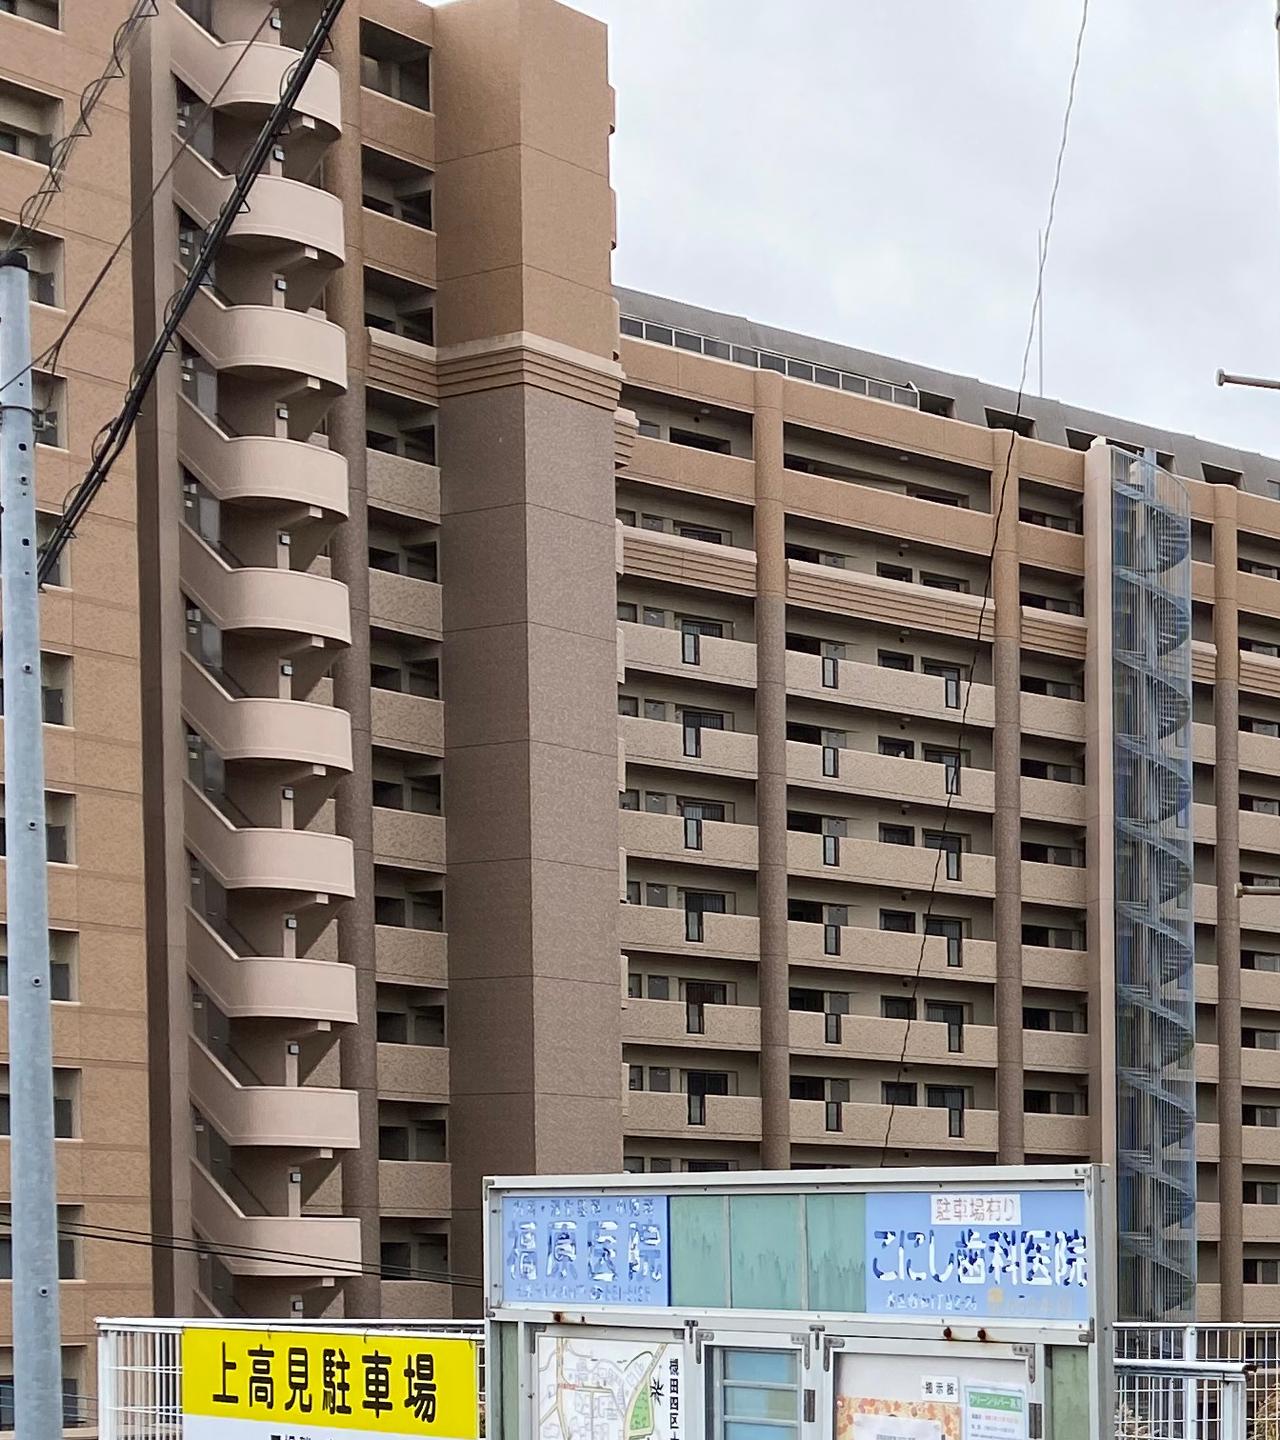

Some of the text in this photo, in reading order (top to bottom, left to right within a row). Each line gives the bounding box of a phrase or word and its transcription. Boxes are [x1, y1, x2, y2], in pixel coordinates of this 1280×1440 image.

[212, 1341, 436, 1423] 上高見駐車場
